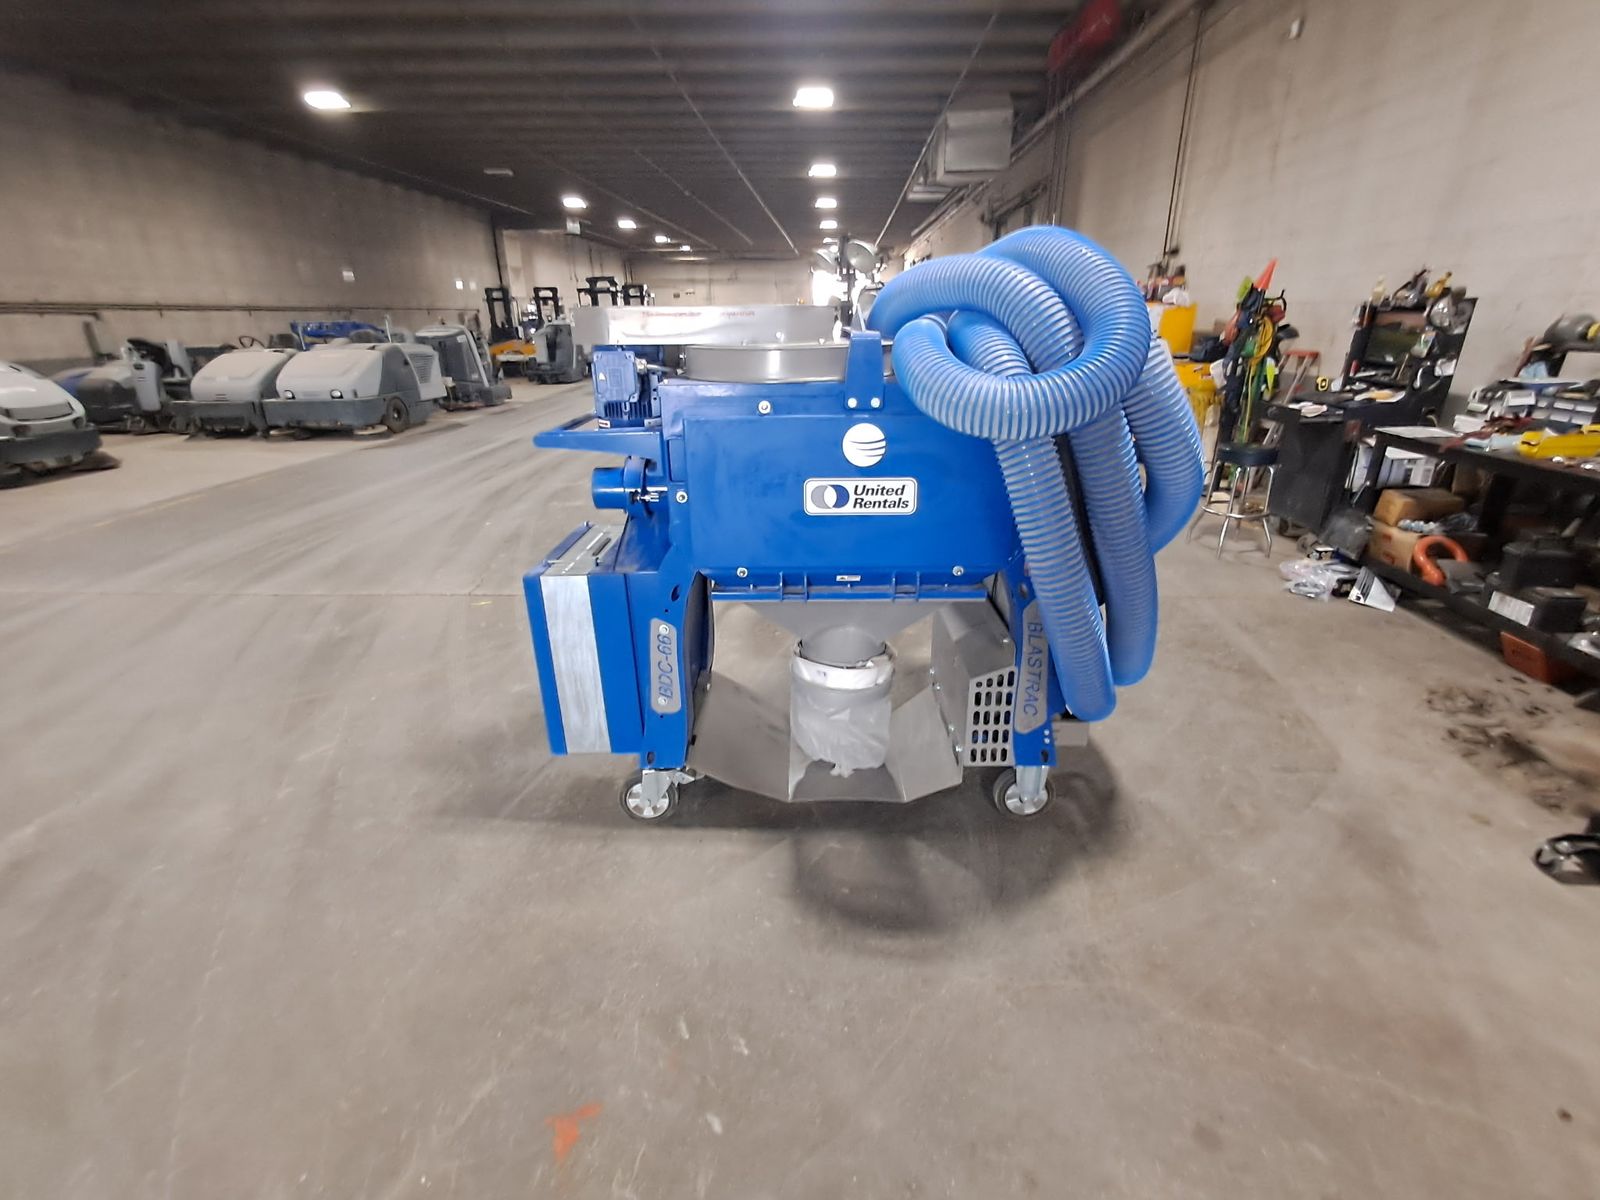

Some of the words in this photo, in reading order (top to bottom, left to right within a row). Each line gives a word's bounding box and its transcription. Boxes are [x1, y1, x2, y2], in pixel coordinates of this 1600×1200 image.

[852, 497, 910, 509] Rentals
[853, 484, 906, 496] United
[656, 633, 673, 700] BDC-66
[1023, 622, 1043, 718] BLASTRAC
